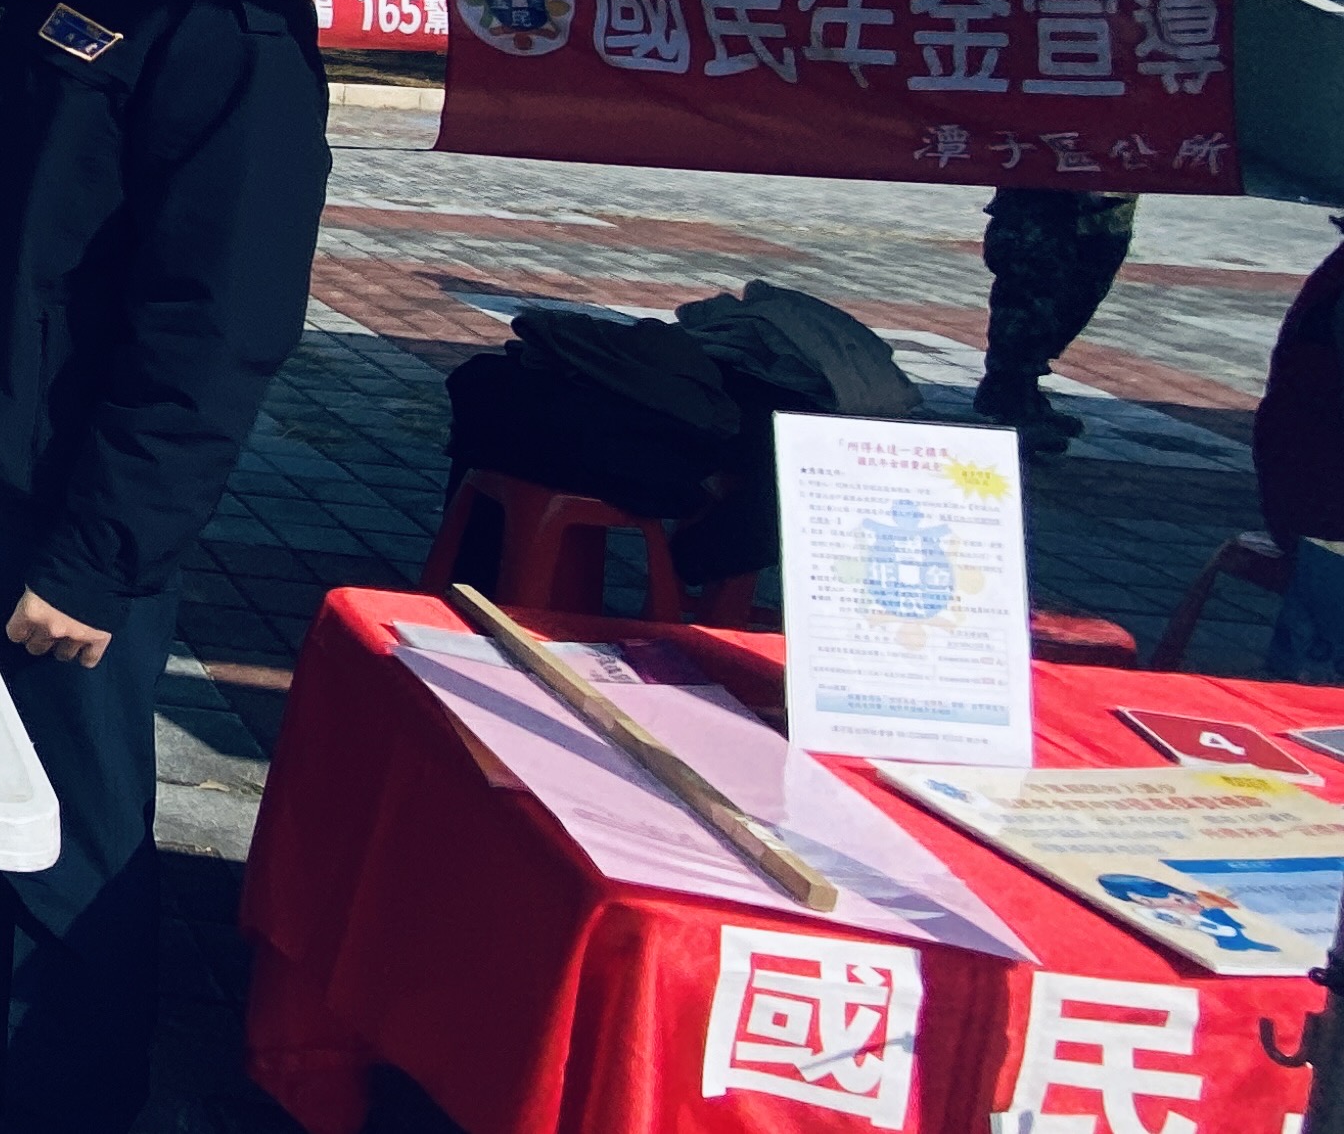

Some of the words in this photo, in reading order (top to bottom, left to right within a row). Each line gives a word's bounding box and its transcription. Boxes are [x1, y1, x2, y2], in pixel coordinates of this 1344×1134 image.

[913, 123, 1230, 177] 潭子區公所
